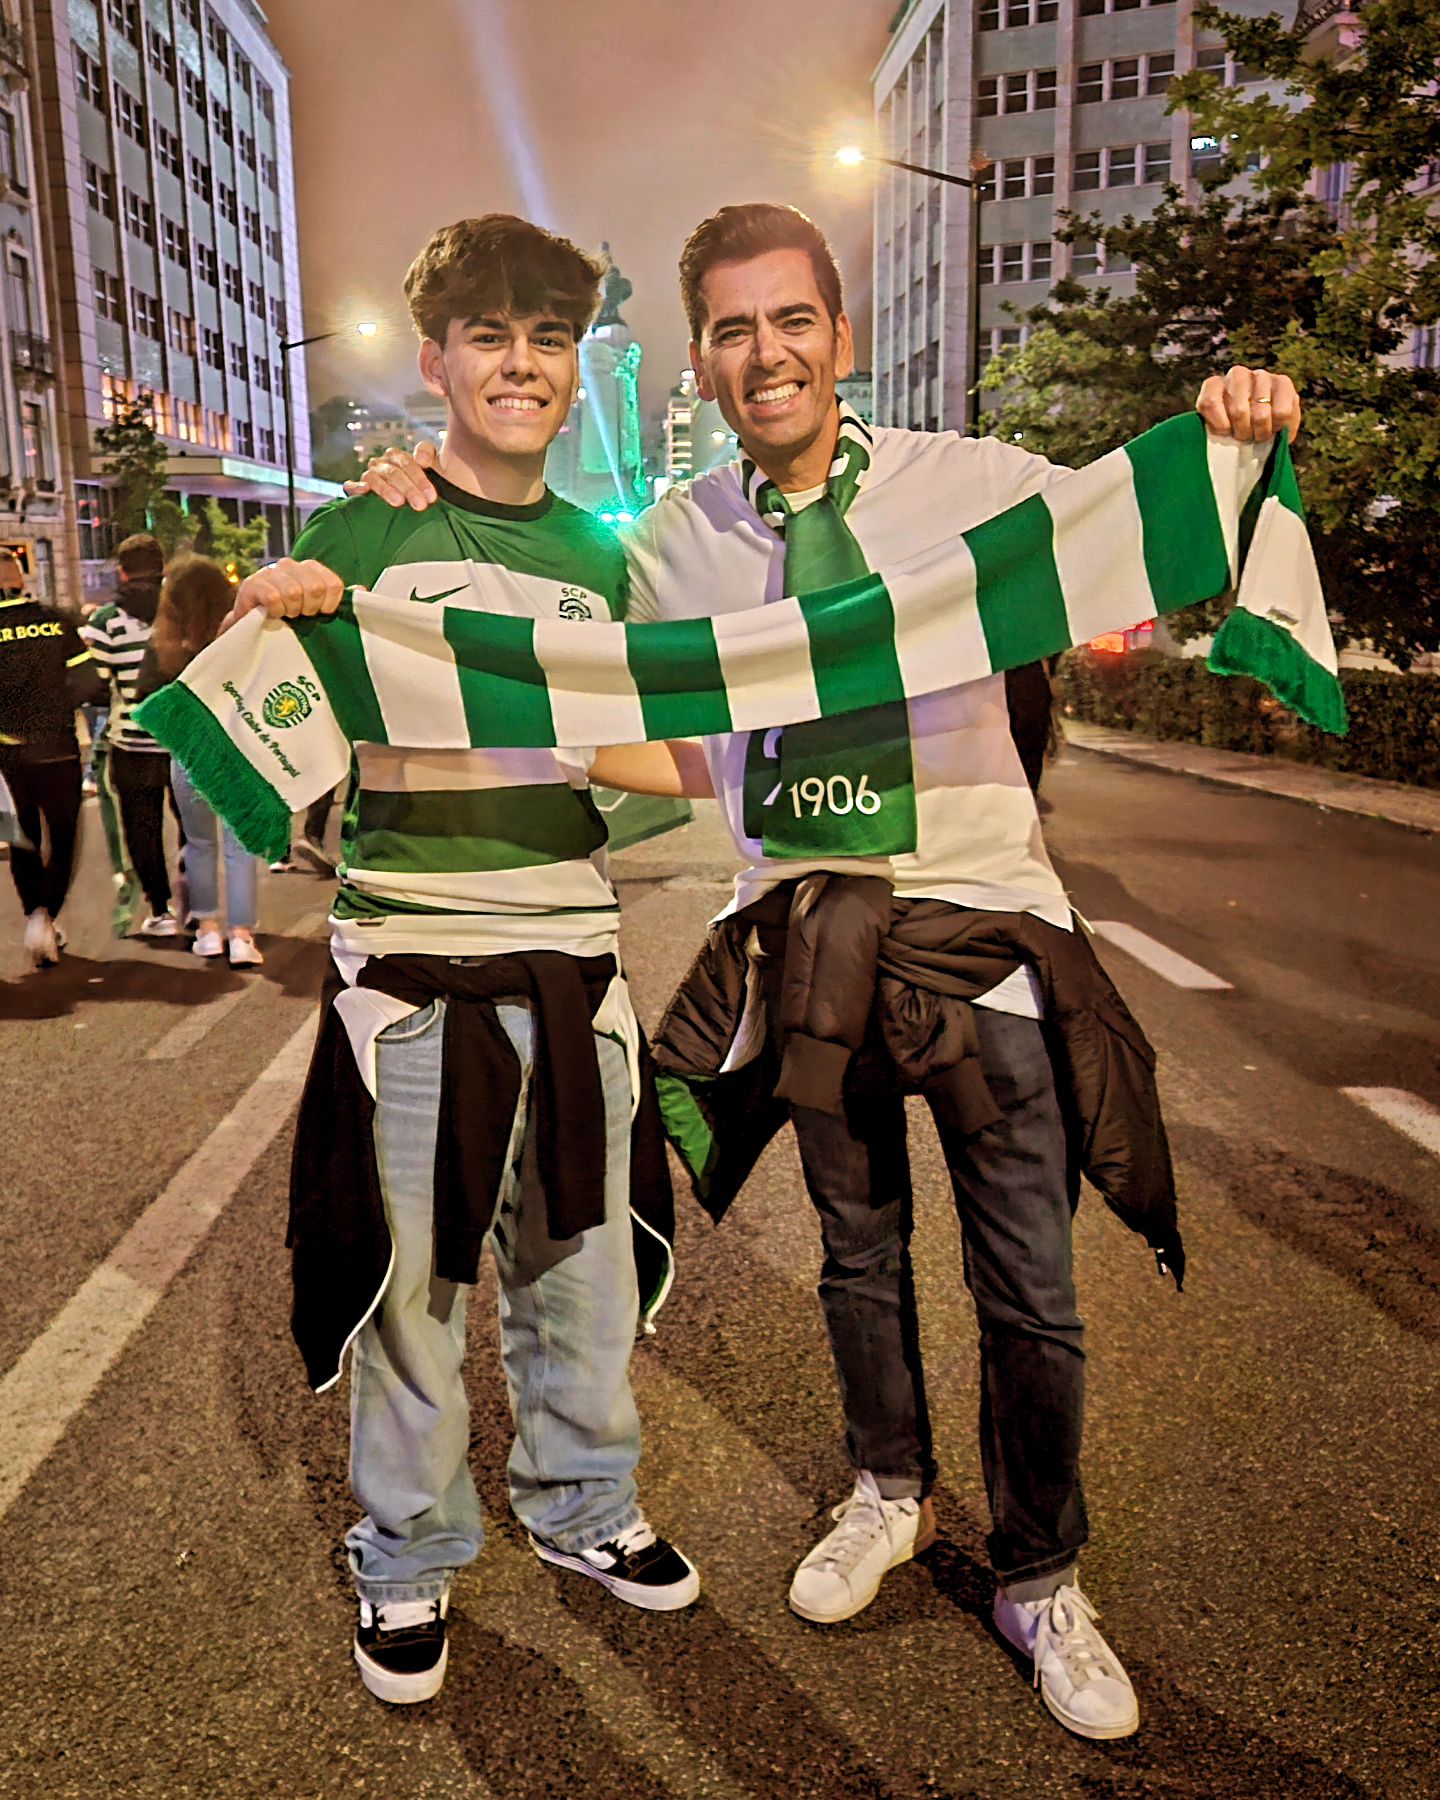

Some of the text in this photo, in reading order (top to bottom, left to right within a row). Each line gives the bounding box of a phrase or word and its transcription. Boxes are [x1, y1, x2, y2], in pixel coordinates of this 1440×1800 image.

[560, 587, 588, 599] SCP
[0, 622, 64, 642] R BOCK
[296, 675, 321, 701] SCP
[222, 681, 245, 712] Sporting
[241, 711, 262, 733] Clube
[258, 733, 270, 744] de
[268, 742, 301, 778] Portugal
[787, 774, 881, 818] 1906
